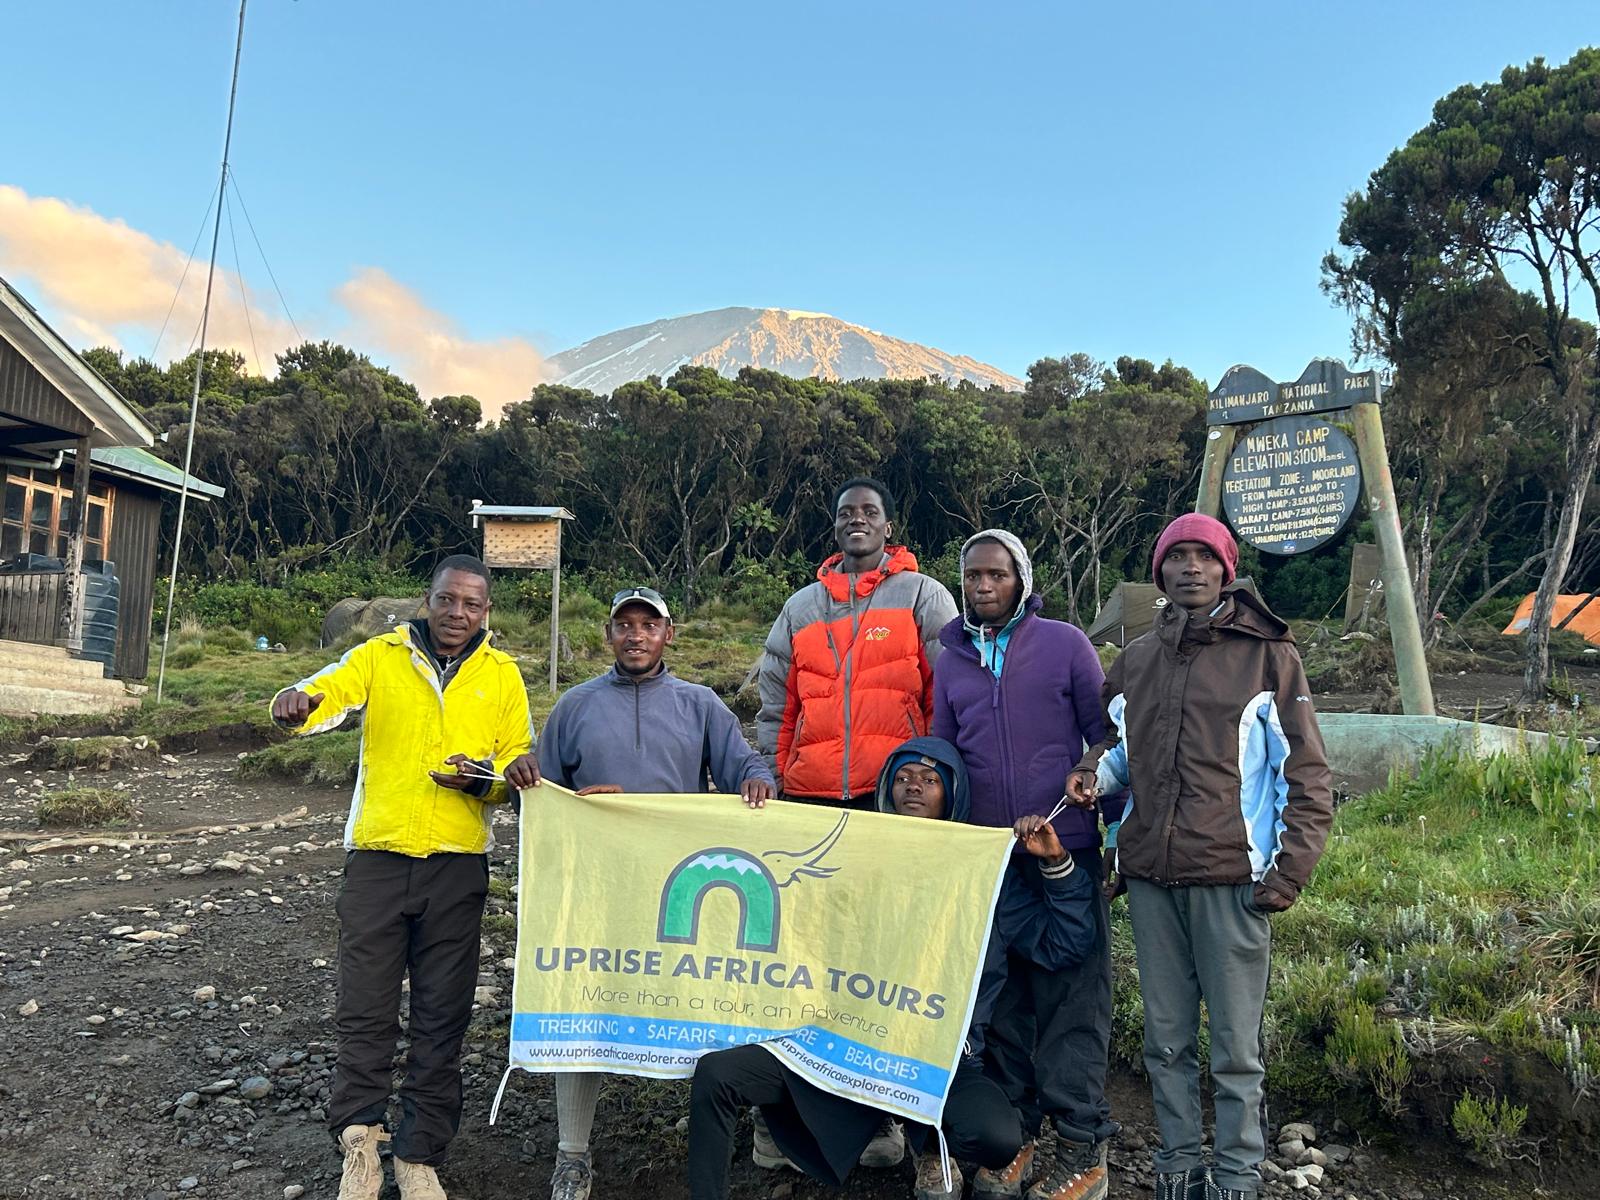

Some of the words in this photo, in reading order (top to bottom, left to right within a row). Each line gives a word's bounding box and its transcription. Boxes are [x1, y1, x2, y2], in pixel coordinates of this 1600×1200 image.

[1209, 391, 1269, 411] KILIMANJARO
[1282, 383, 1329, 399] NATIONAL
[1344, 376, 1370, 391] PARK
[1262, 399, 1315, 416] TANZANIA
[1246, 433, 1289, 454] MWEKA
[1296, 427, 1330, 446] CAMP
[1233, 451, 1292, 473] ELEVATION
[1225, 476, 1271, 494] VEGETATION
[1279, 472, 1305, 486] ZONE:
[1311, 465, 1356, 481] MOORLAND
[1241, 491, 1265, 503] FROM
[1267, 486, 1296, 499] MWEKA
[1299, 483, 1323, 494] CAMP
[1326, 481, 1338, 490] TO
[1238, 513, 1269, 525] BARAFU
[1242, 502, 1263, 514] HIGH
[535, 947, 662, 976] UPRISE
[672, 953, 814, 990] AFRICA
[827, 967, 946, 1020] TOURS
[582, 985, 629, 1004] More
[637, 989, 679, 1008] than
[689, 997, 704, 1009] a
[713, 996, 755, 1017] tour,
[762, 1003, 792, 1019] an
[800, 1003, 889, 1038] Adventure
[537, 1018, 619, 1036] TREKKING
[647, 1023, 718, 1043] SAFARIS
[844, 1046, 920, 1081] BEACHES
